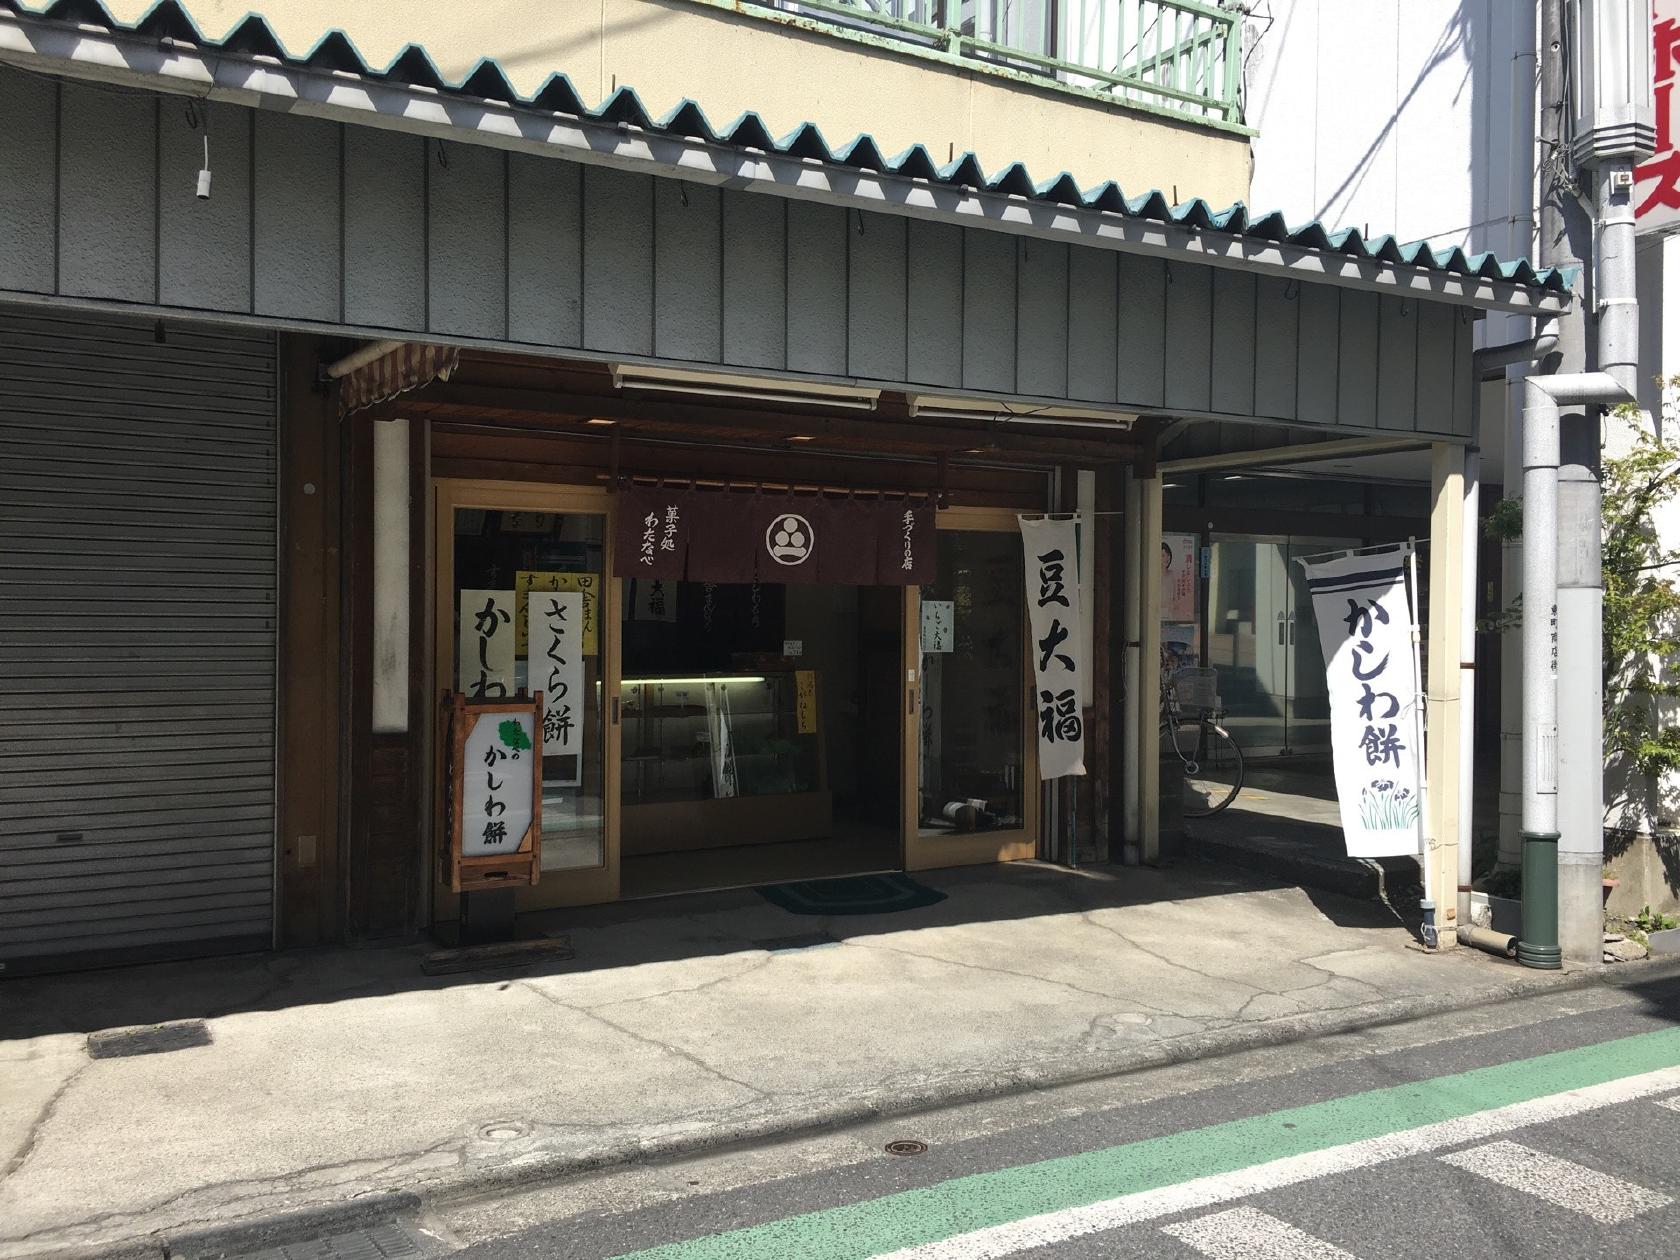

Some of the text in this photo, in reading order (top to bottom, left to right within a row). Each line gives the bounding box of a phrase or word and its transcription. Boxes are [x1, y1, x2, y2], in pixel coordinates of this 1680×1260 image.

[639, 511, 659, 566] わたなべ
[660, 505, 679, 552] 菓子処
[902, 509, 915, 571] 手づくりの店
[543, 597, 576, 746] さくら餅
[1037, 549, 1082, 743] 豆大福
[1343, 599, 1406, 769] かしわ餅
[482, 745, 507, 845] かしわ餅
